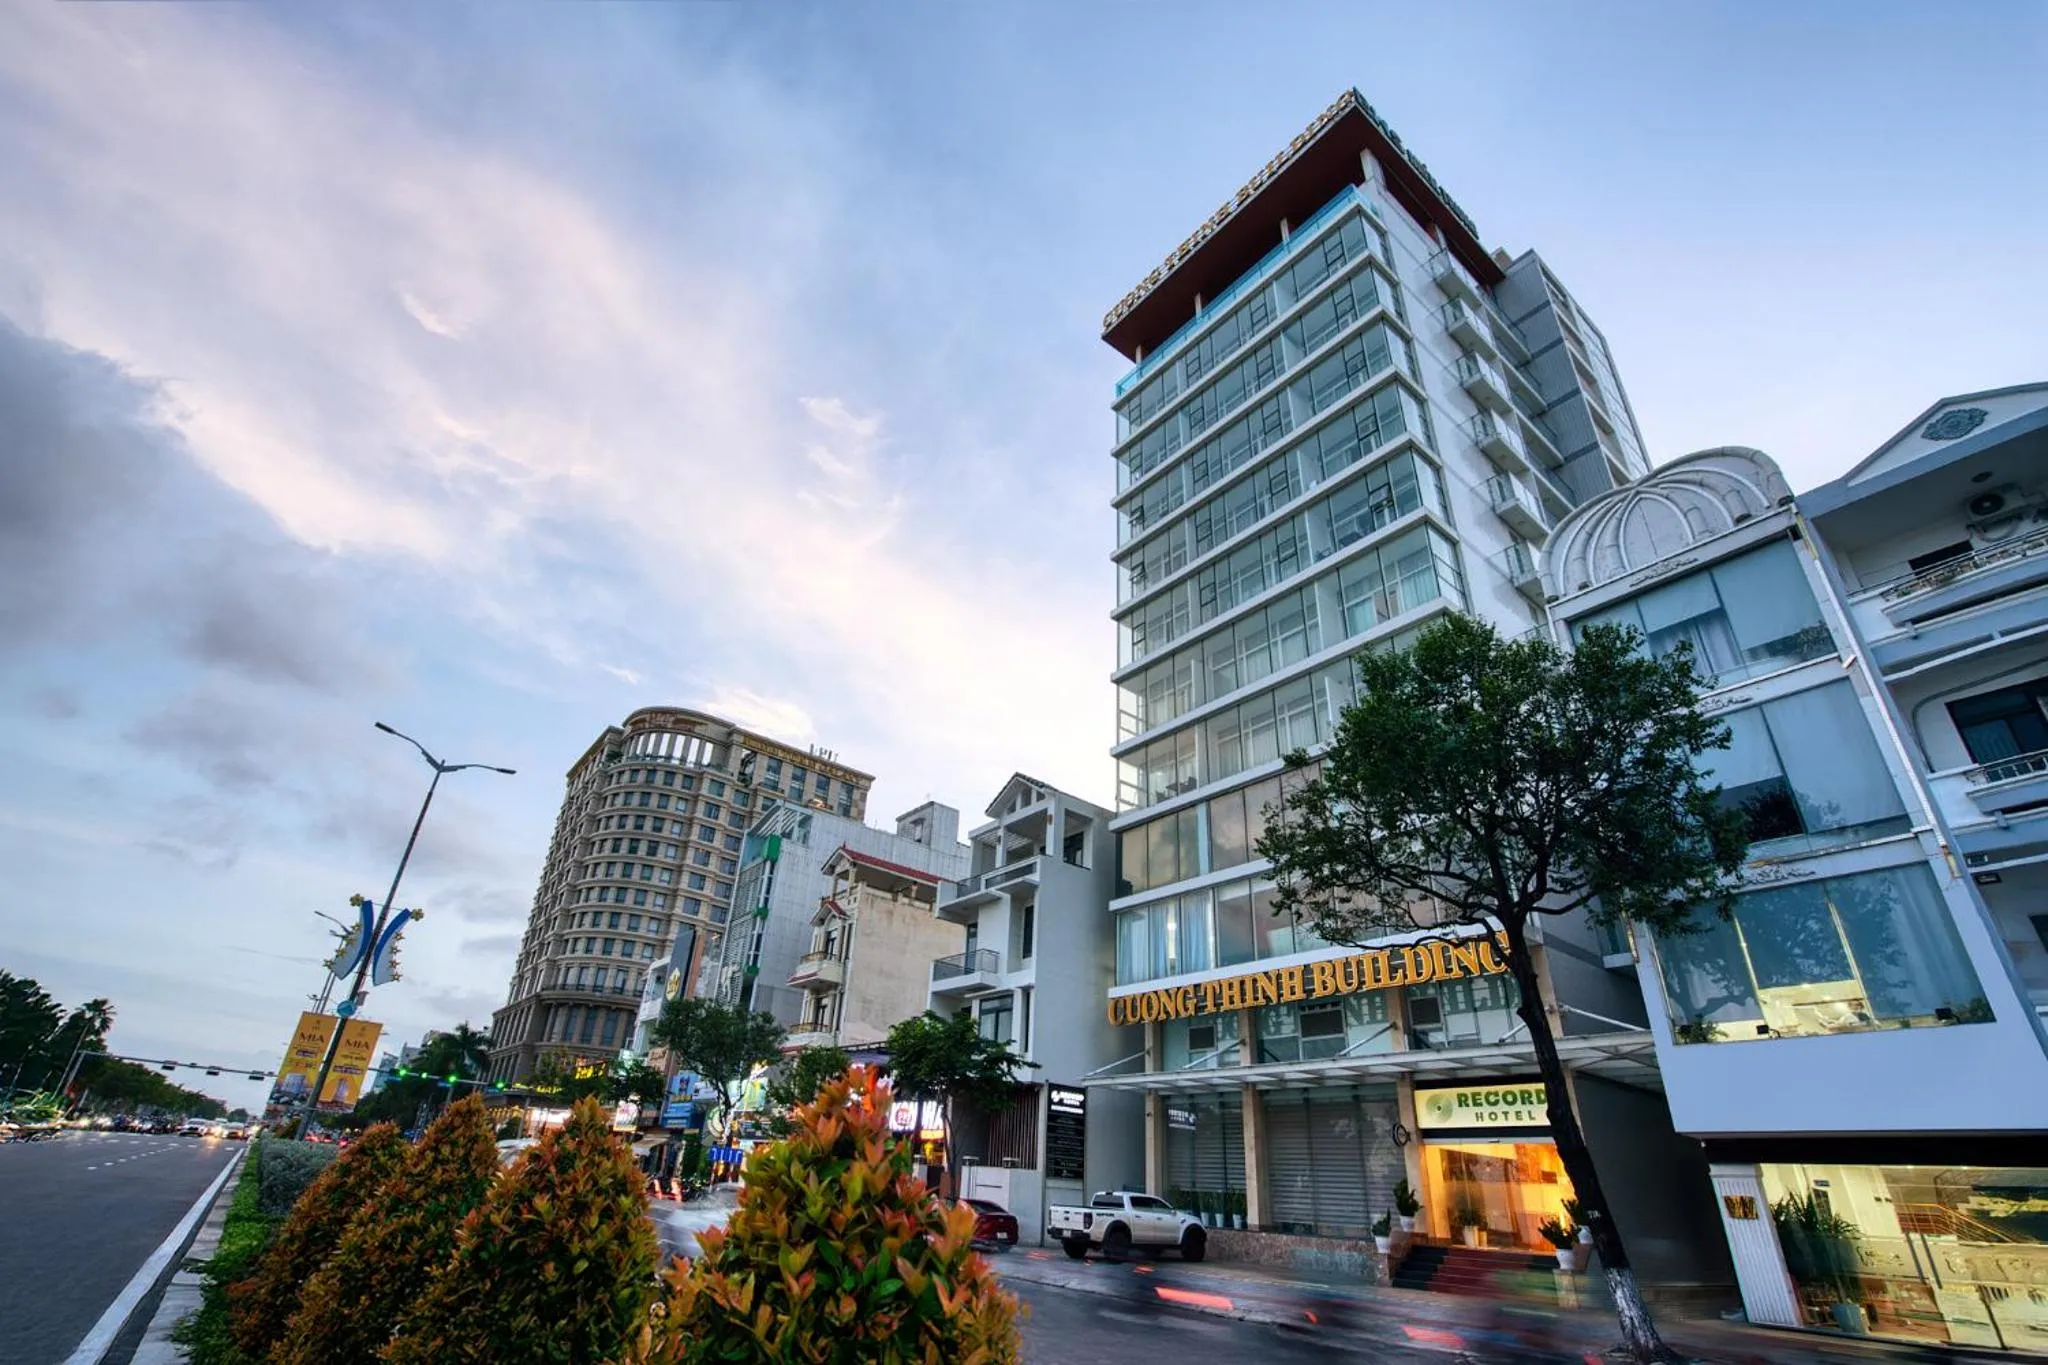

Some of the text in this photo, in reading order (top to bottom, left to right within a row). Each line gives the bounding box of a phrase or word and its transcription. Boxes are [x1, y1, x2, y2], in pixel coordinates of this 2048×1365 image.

[1108, 986, 1197, 1026] CUONG
[1202, 965, 1307, 1014] THINH
[1456, 1088, 1548, 1108] RECORD
[1475, 1110, 1536, 1122] HOTEL
